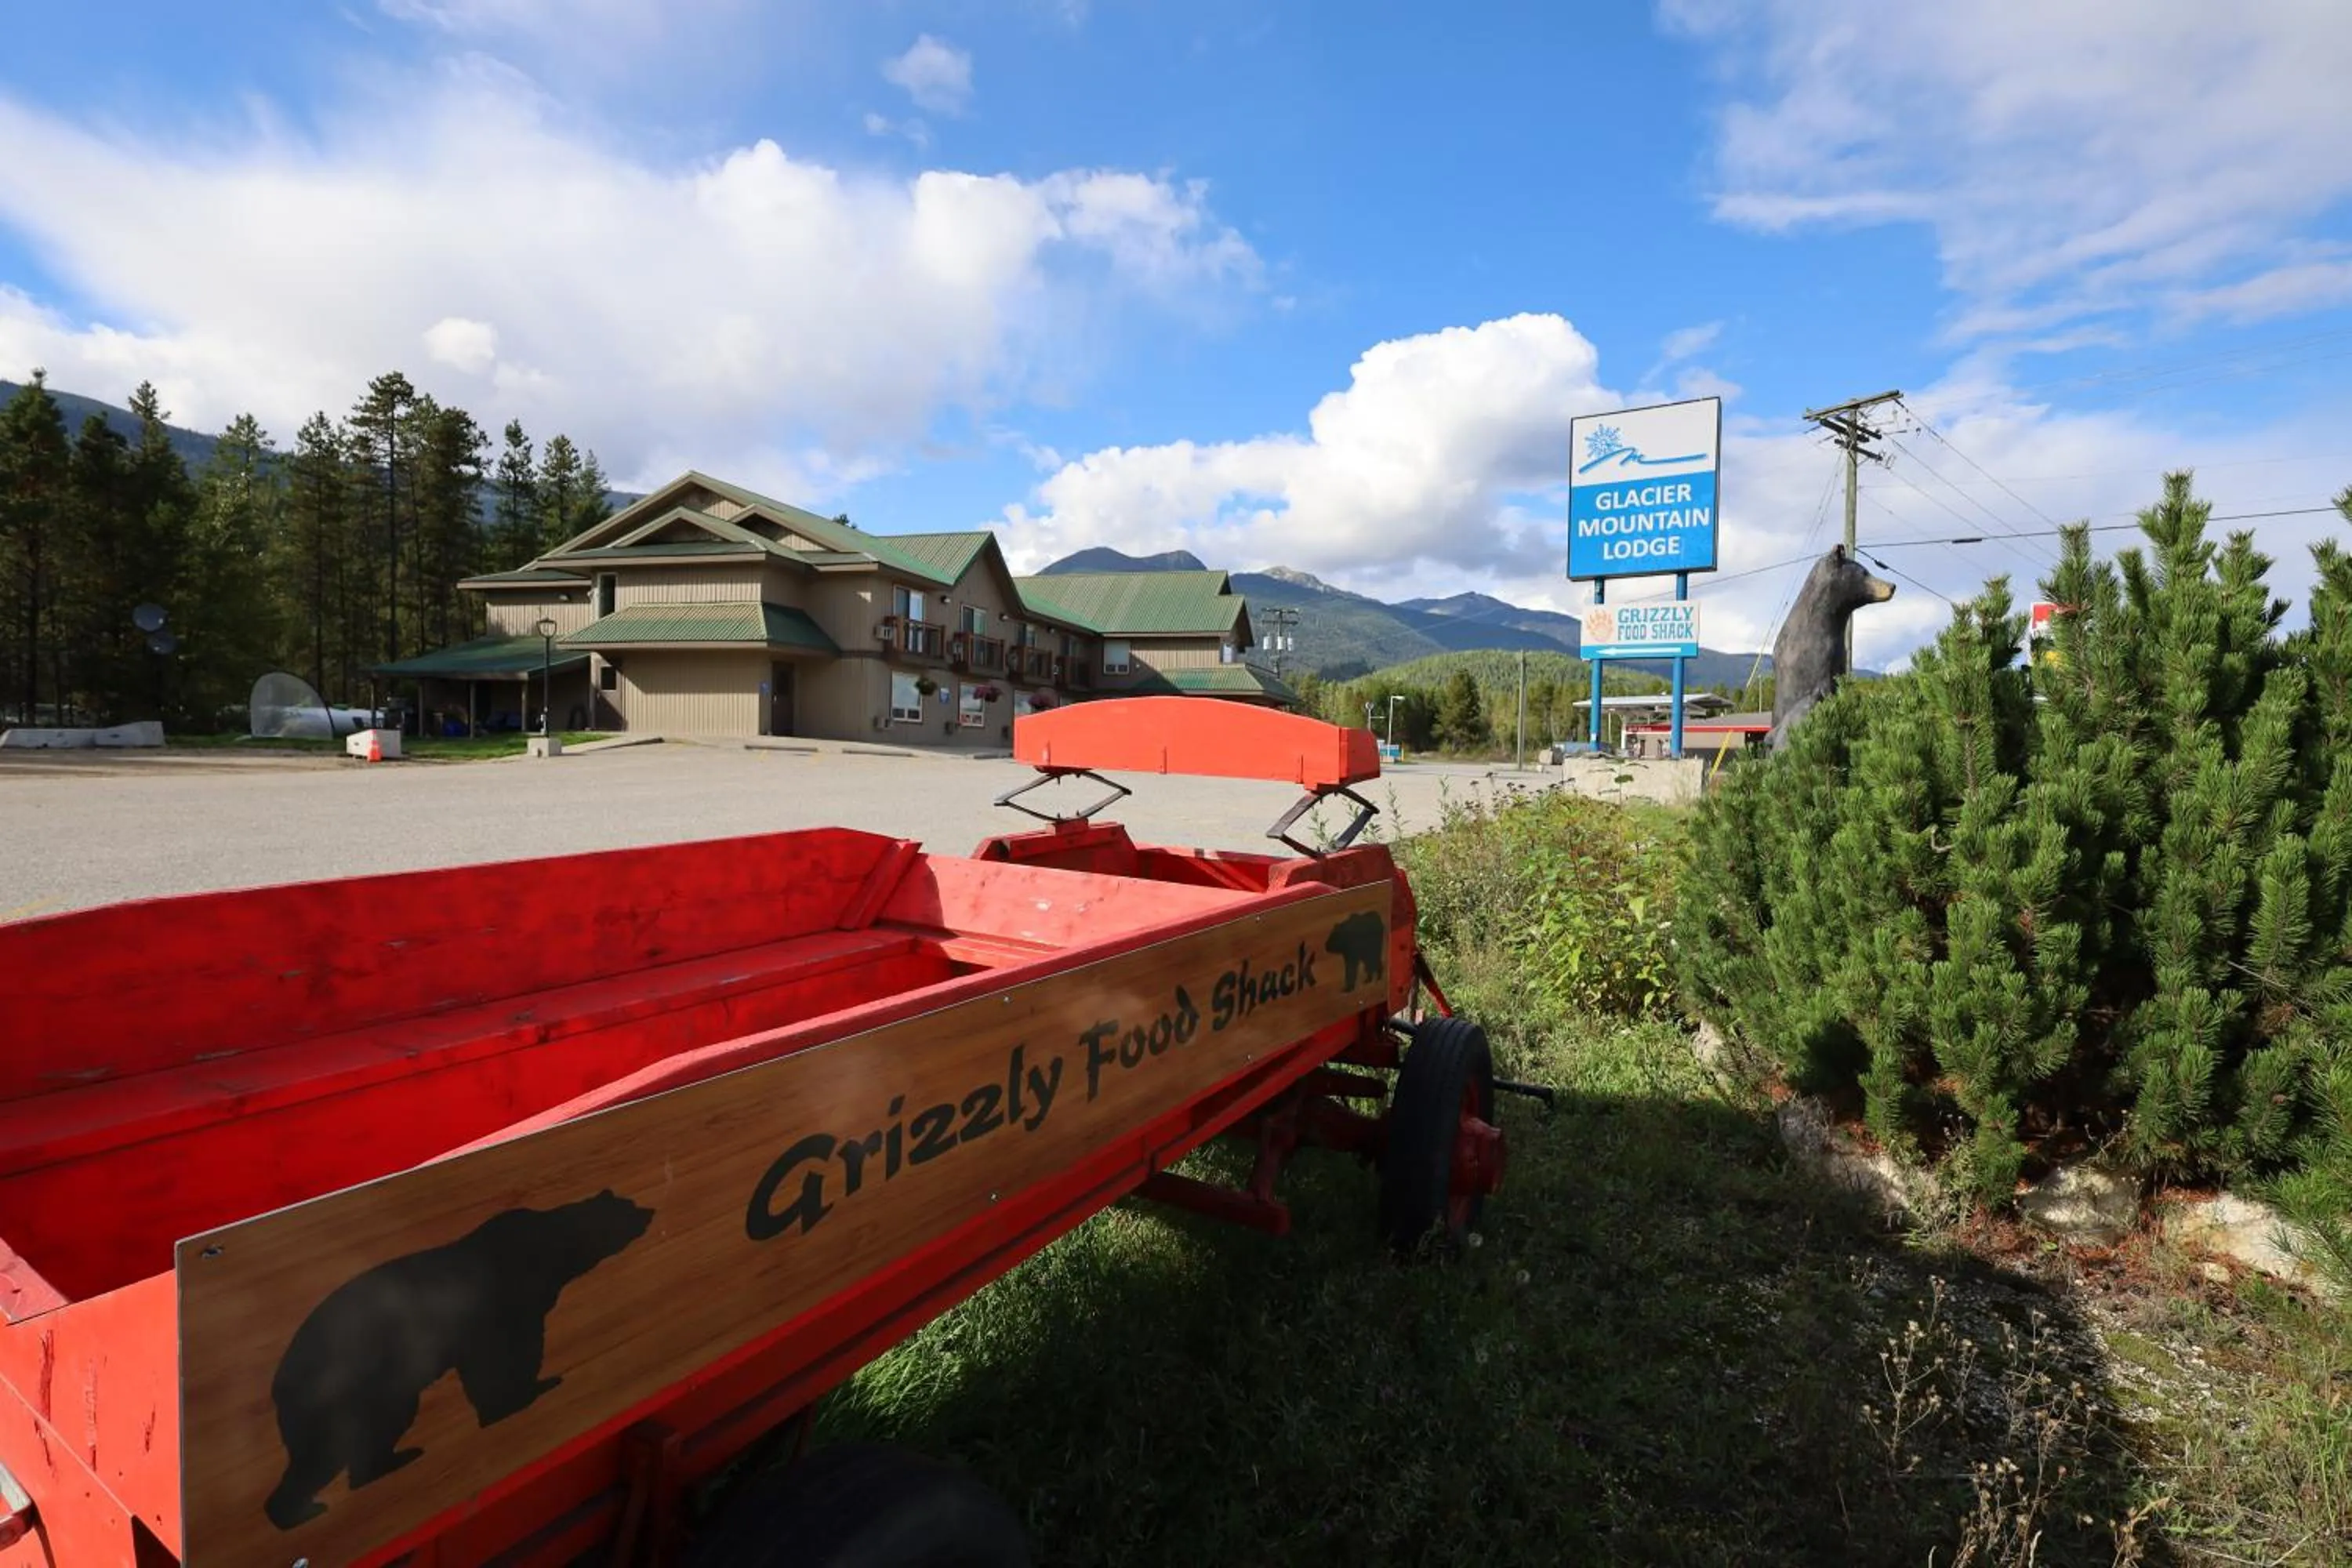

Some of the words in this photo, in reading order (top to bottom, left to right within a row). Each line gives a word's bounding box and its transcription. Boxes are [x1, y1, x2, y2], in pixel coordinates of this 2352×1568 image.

[1595, 483, 1691, 511] GLACIER
[1578, 507, 1710, 537] MOUNTAIN
[1603, 535, 1681, 561] LODGE
[1617, 605, 1694, 623] GRIZZLY
[1617, 624, 1646, 641] FOOD
[1651, 622, 1693, 640] SHACK
[745, 1044, 1063, 1241] Grizzly
[1077, 985, 1200, 1102] Food
[1211, 941, 1318, 1033] Shack
